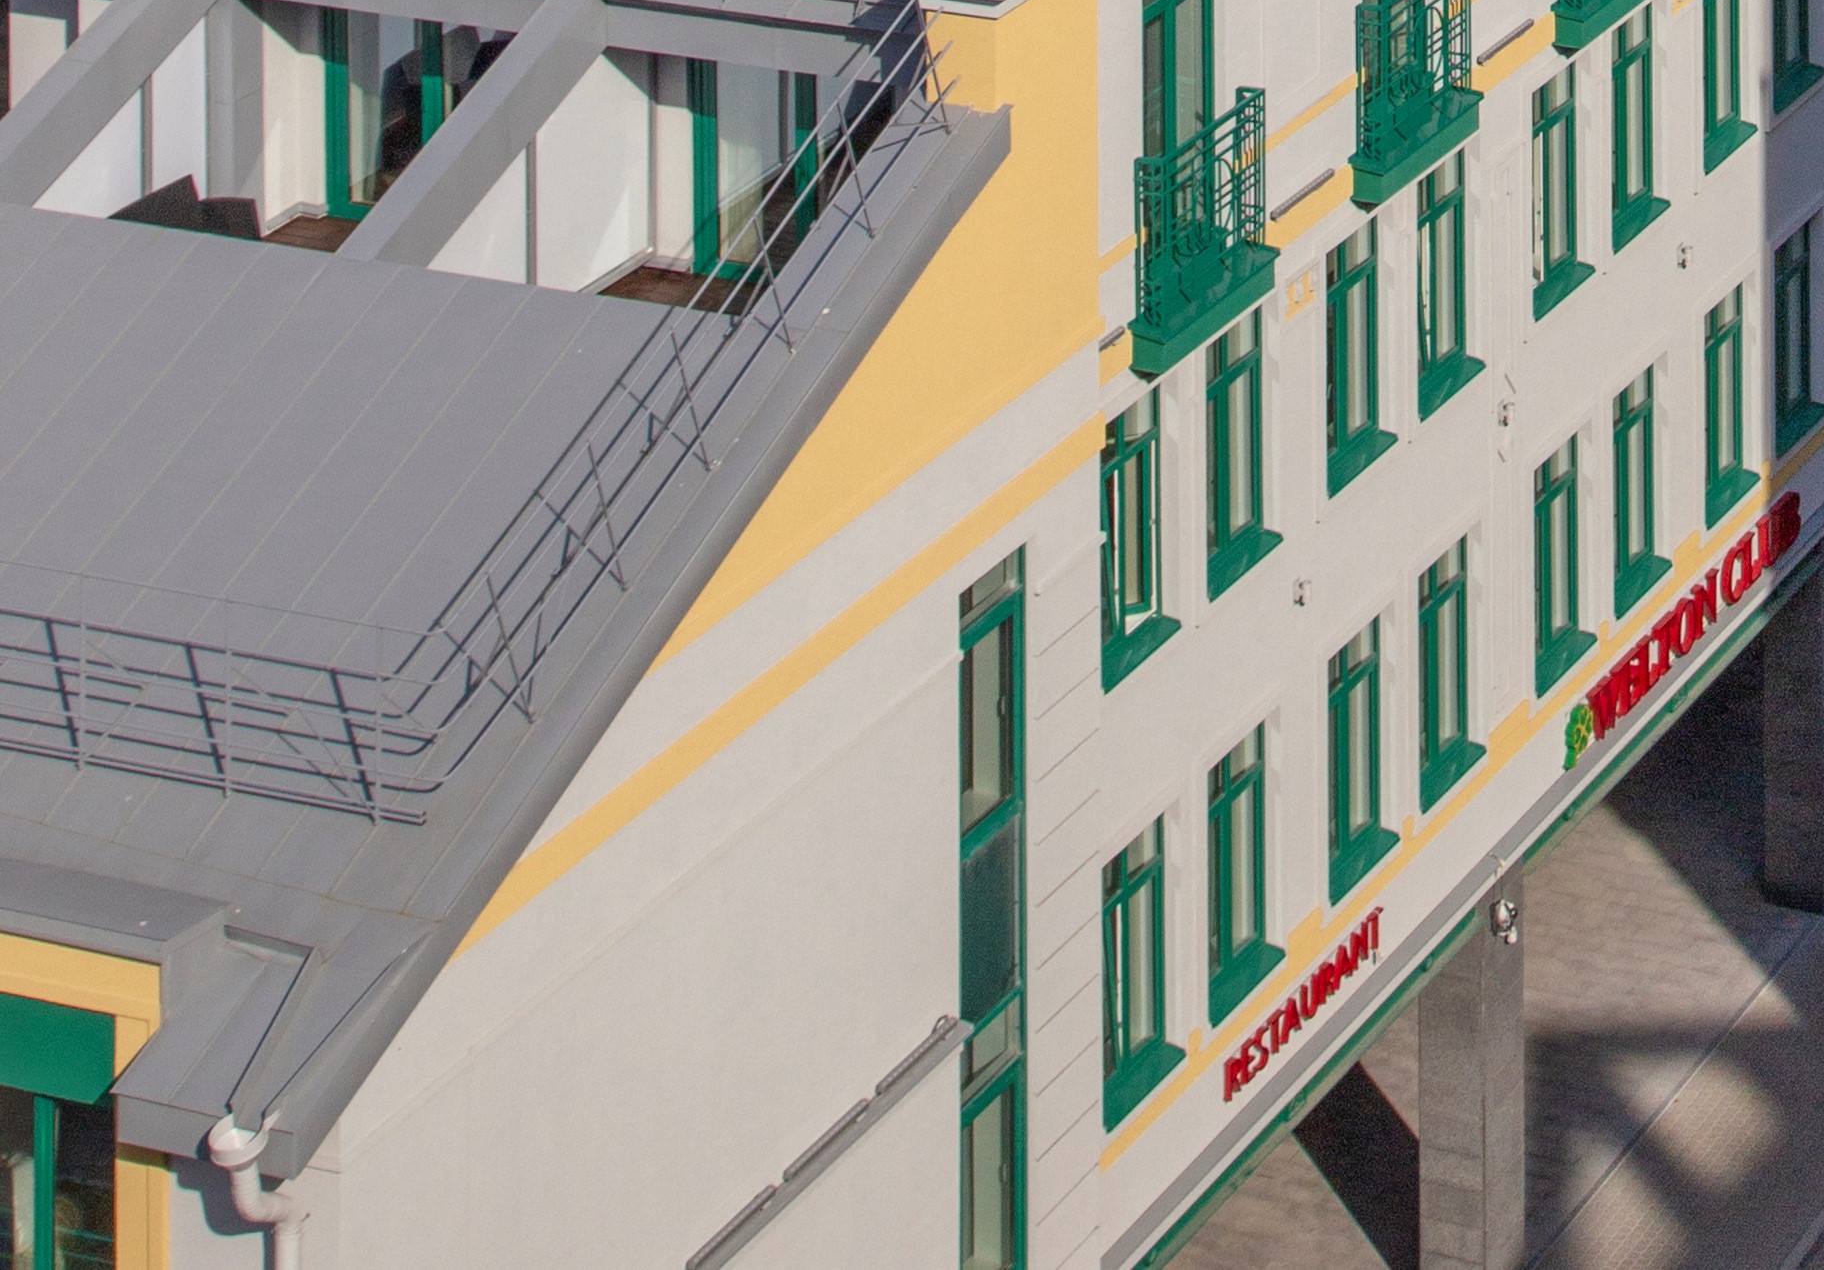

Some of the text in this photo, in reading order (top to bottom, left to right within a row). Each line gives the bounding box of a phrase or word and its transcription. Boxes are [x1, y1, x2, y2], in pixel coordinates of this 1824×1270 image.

[1586, 491, 1801, 741] WELTON CLUB
[1223, 906, 1384, 1103] RESTAURANT
